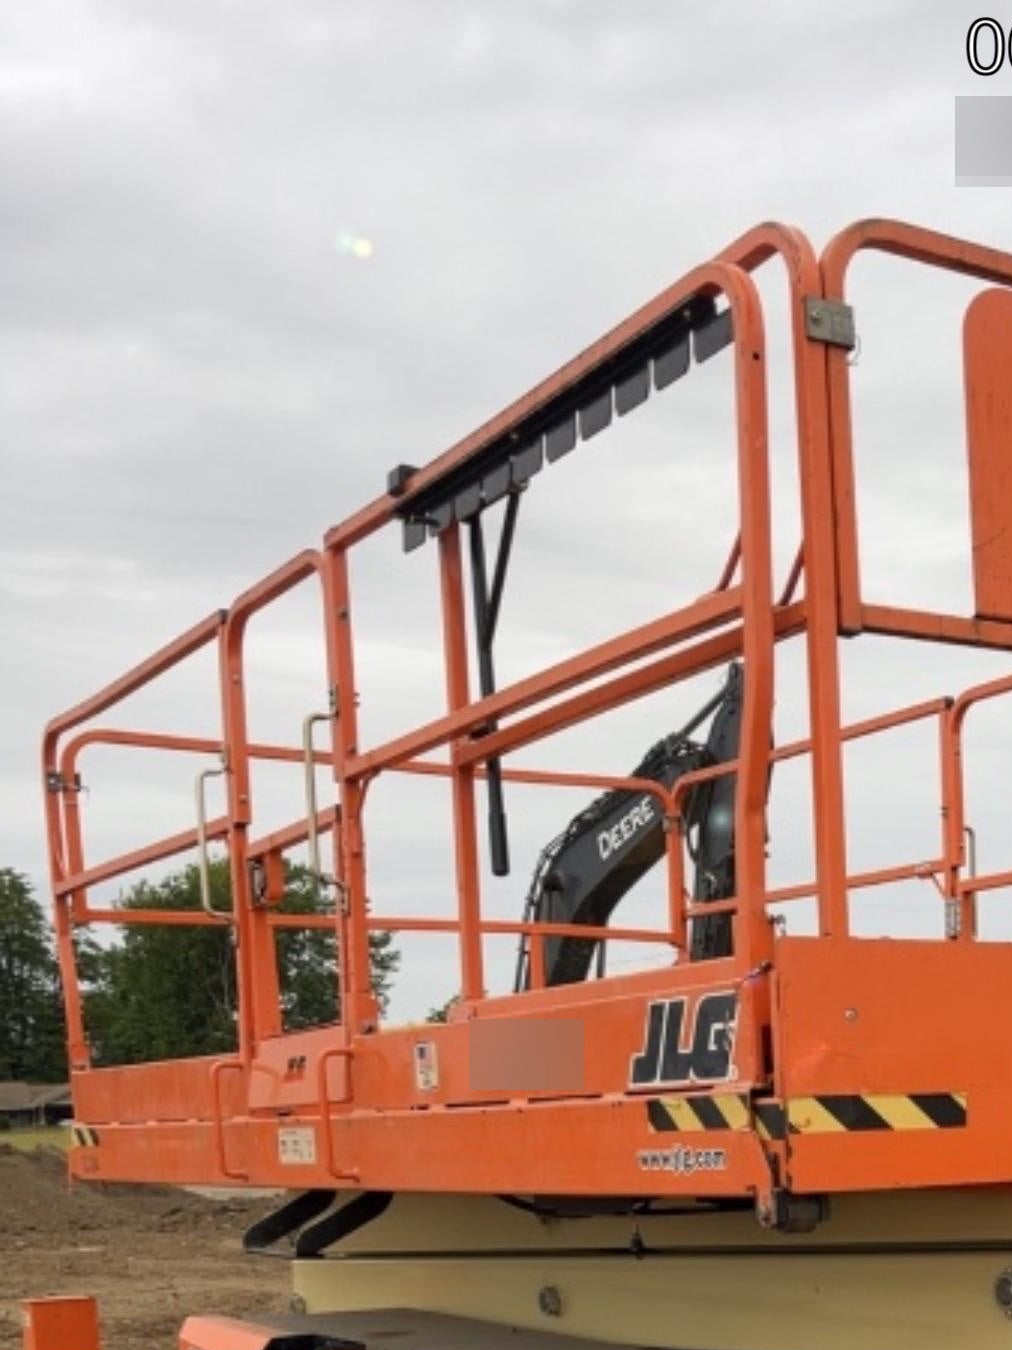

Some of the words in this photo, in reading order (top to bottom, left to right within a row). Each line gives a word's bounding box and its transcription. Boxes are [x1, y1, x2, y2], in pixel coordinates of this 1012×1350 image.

[597, 796, 655, 861] DEERE
[628, 989, 741, 1088] JLG
[637, 1145, 728, 1175] www.jlg.com
